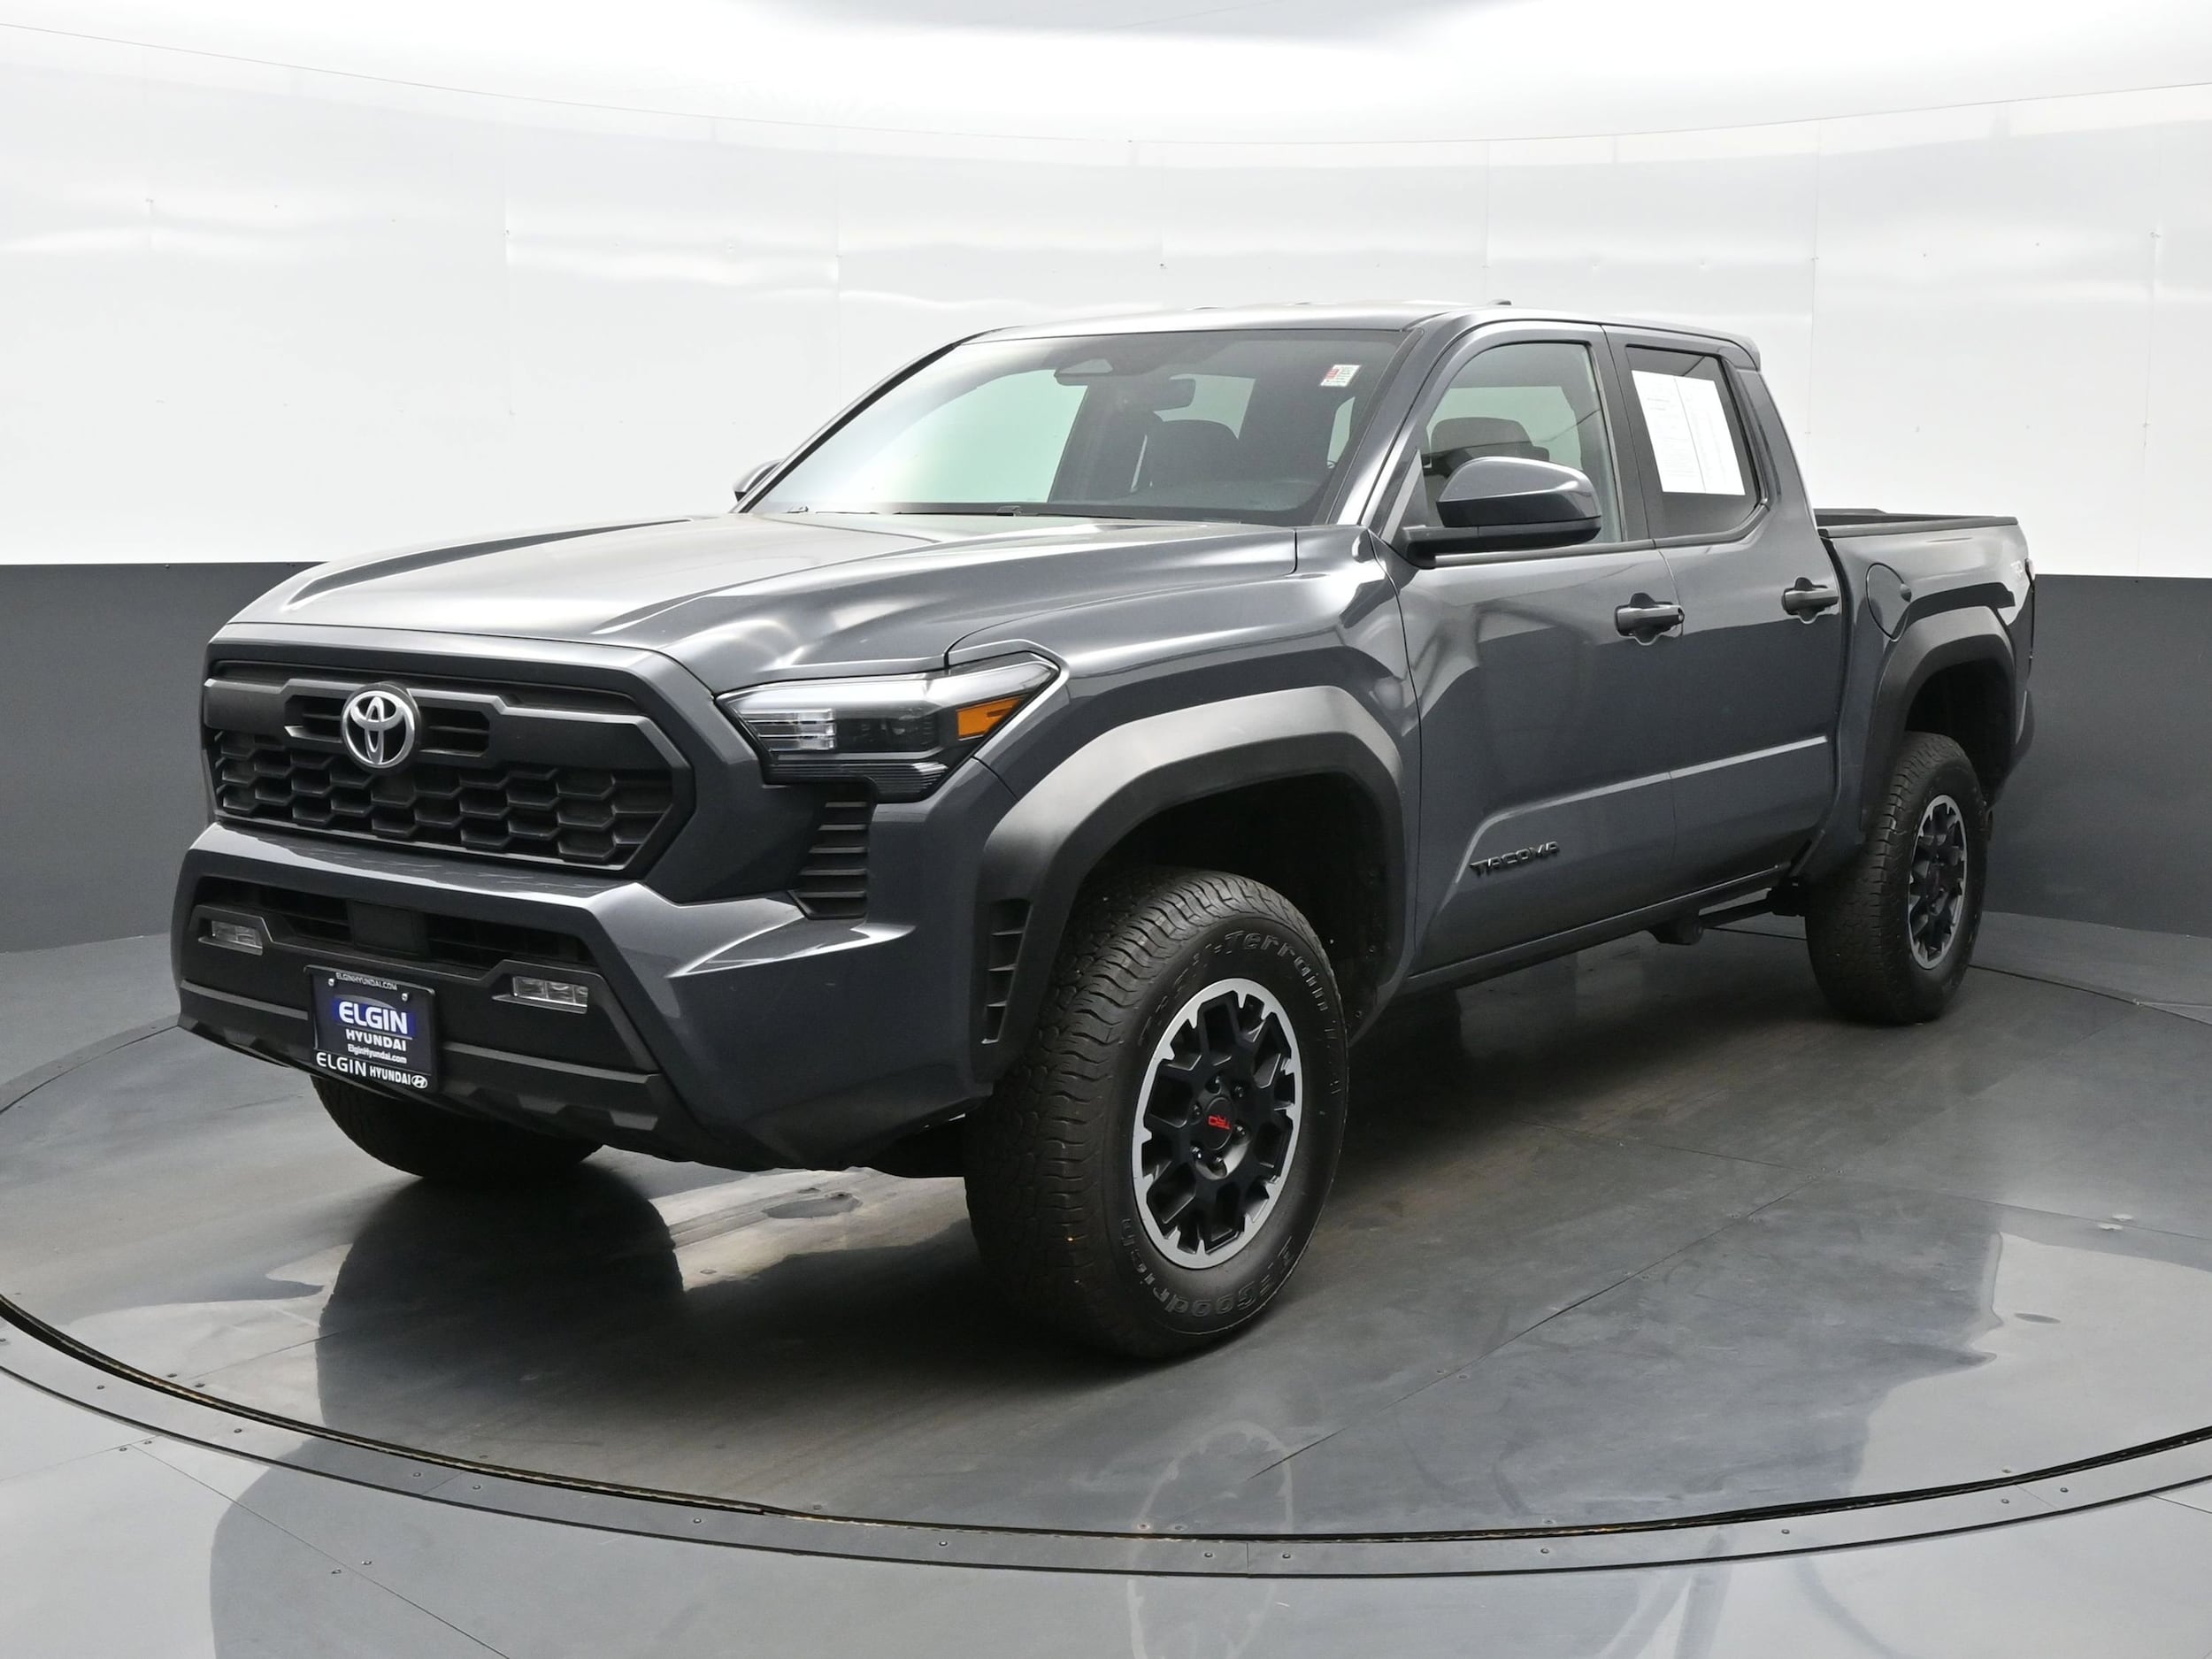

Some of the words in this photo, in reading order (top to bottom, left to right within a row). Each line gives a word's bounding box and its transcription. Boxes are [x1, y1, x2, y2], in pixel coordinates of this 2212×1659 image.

[335, 972, 398, 991] ELGINHYUNDAI.COM
[339, 1001, 408, 1034] ELGIN
[345, 1028, 407, 1051] HYUNDAI
[347, 1043, 407, 1064] ElginHyundai.com
[316, 1052, 366, 1077] ELGIN
[369, 1065, 411, 1085] HYUNDAI
